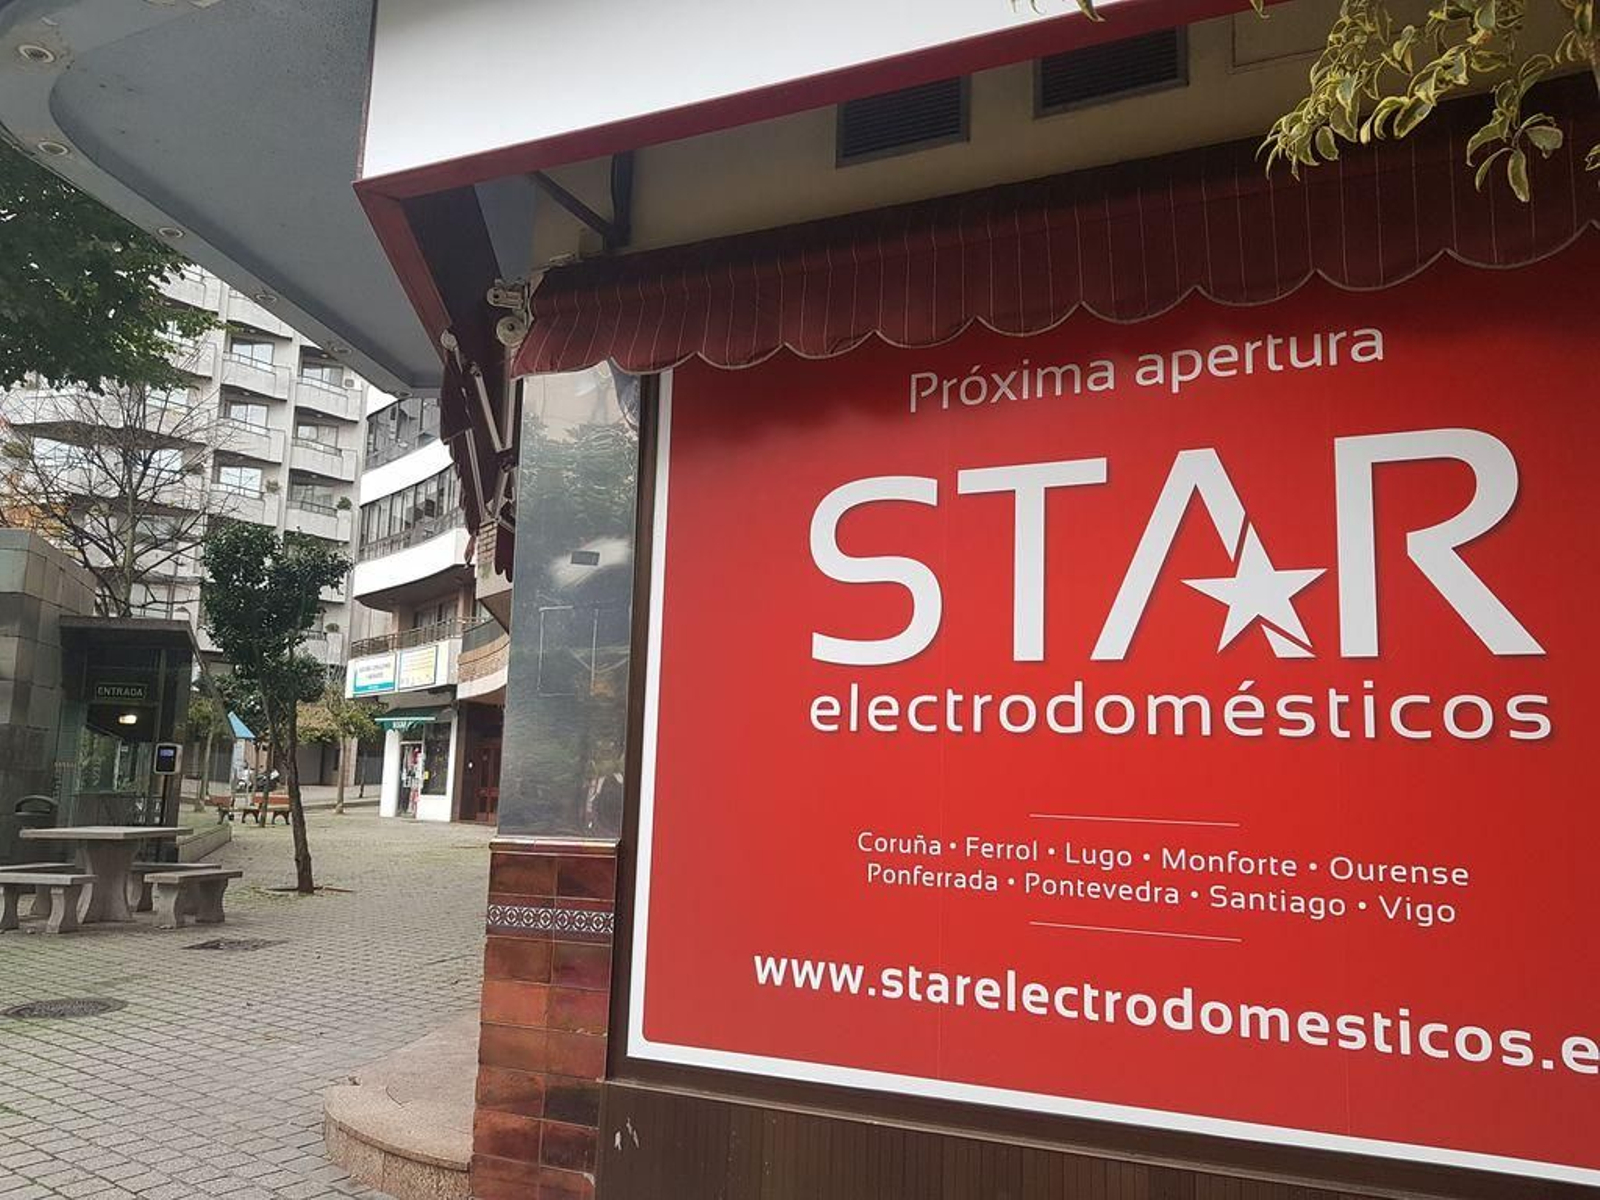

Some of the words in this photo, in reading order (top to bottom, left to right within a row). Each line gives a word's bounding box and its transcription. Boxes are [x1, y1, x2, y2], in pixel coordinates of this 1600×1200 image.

[908, 358, 1116, 413] Próxima
[1136, 328, 1384, 395] apertura
[809, 427, 1547, 666] STAR
[97, 686, 143, 697] ENTRADA
[809, 680, 1552, 740] electrodomésticos
[857, 831, 942, 856] Coruña
[966, 837, 1038, 862] Ferrol
[1066, 843, 1132, 871] Lugo
[1162, 847, 1297, 878] Monforte
[1329, 856, 1469, 886] Ourense
[867, 862, 998, 892] Ponferrada
[1025, 872, 1180, 905] Pontevedra
[1209, 885, 1346, 920] Santiago
[1378, 895, 1456, 927] Vigo
[753, 955, 1600, 1075] www.starelectrodomesticos.e
